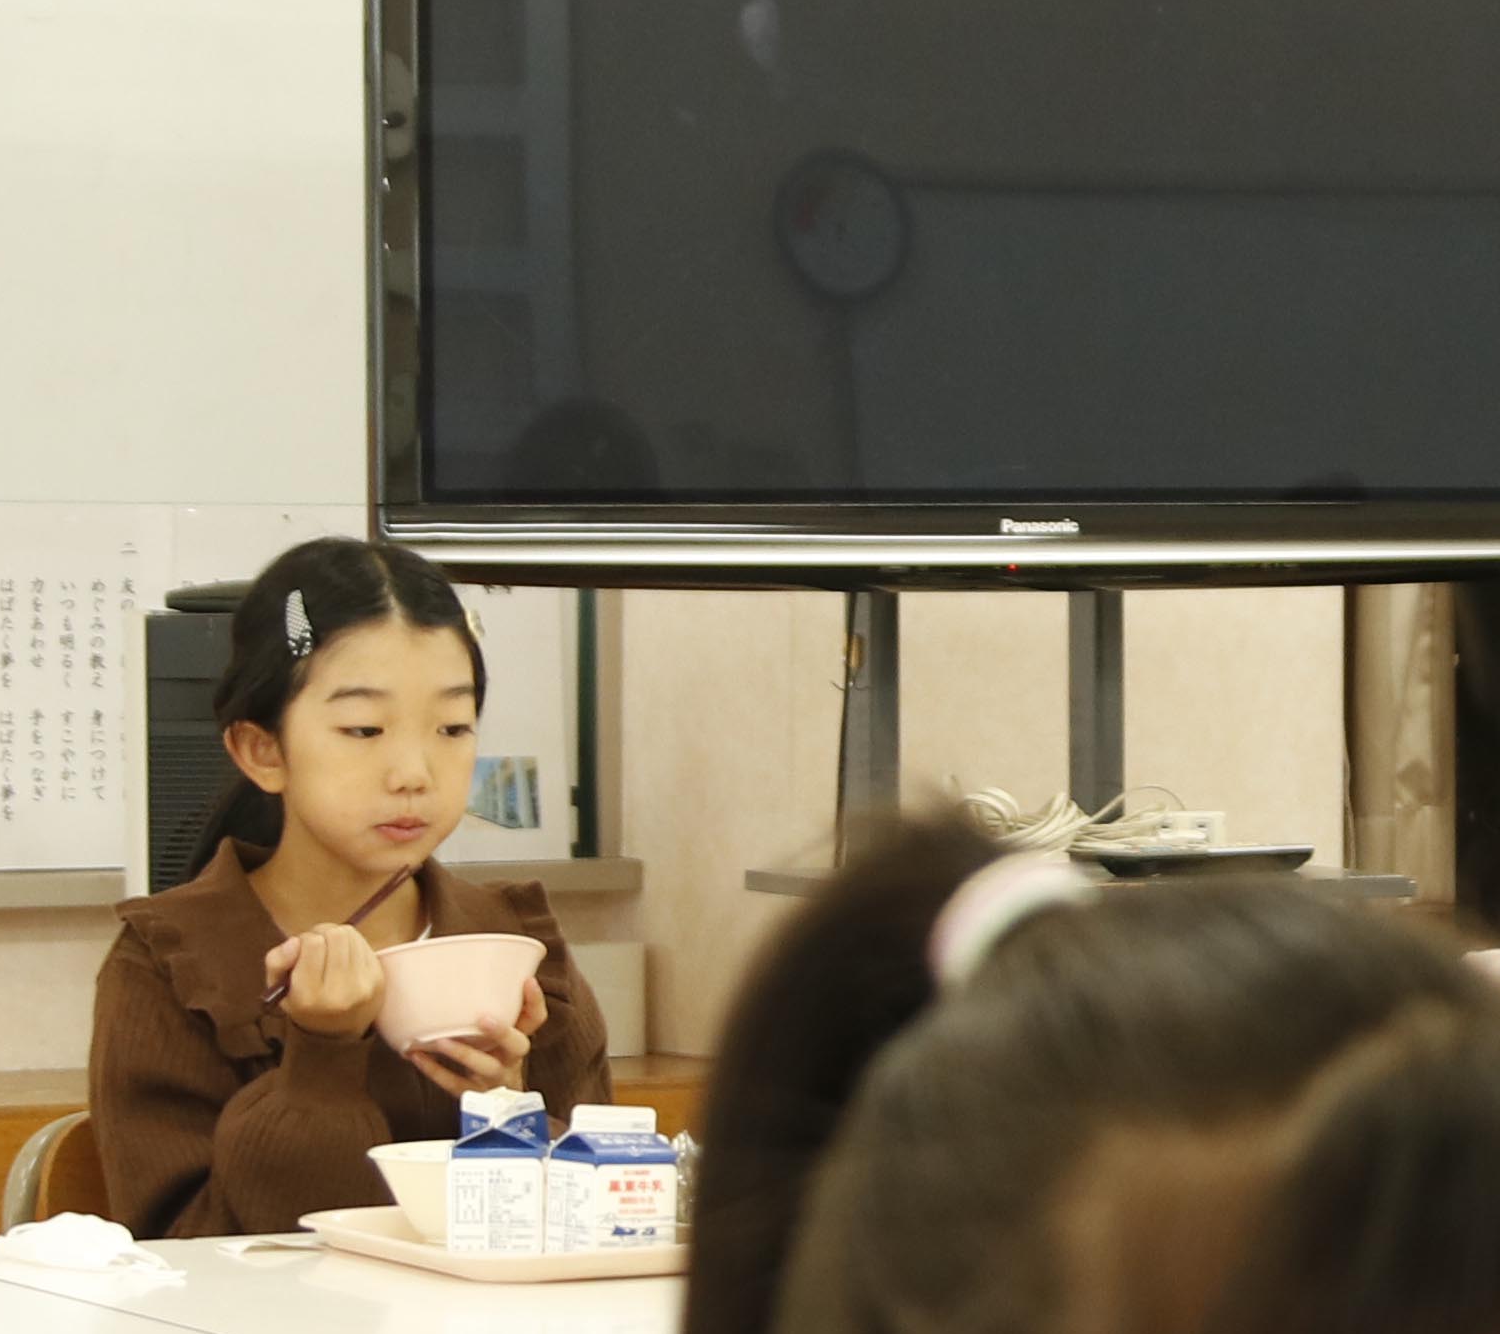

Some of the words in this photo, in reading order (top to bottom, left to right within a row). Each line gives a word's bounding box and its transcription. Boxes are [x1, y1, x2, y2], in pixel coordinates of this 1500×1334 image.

[1001, 518, 1079, 534] Panasonic
[58, 580, 78, 689] いつも明るく
[27, 708, 47, 802] 手をつなぎ
[59, 709, 78, 801] すこやかに
